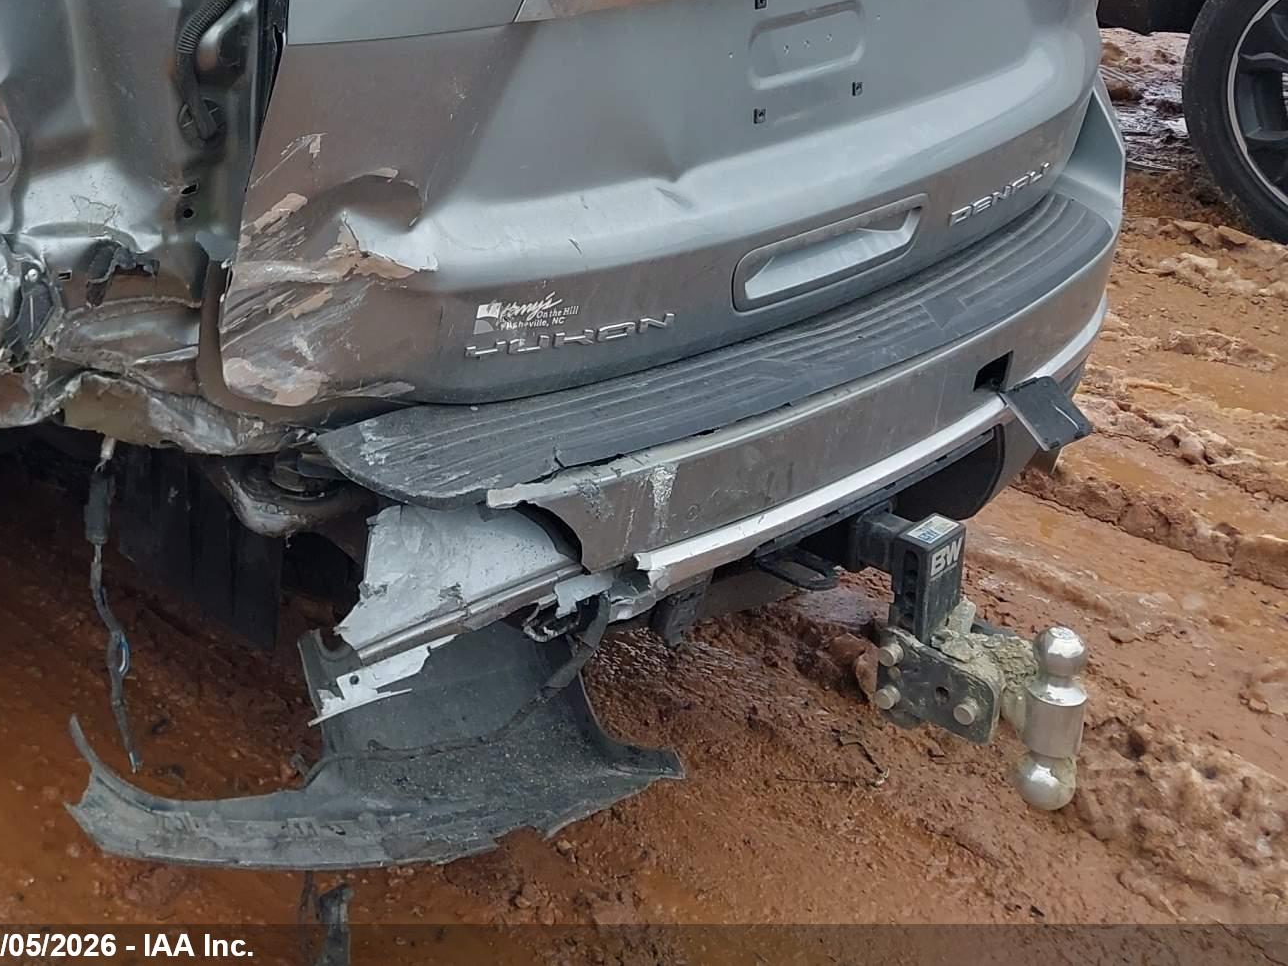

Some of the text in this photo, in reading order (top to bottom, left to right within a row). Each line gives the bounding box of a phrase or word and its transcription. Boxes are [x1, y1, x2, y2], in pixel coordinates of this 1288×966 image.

[947, 161, 1051, 228] DENALI
[552, 316, 566, 326] NC
[563, 305, 579, 316] Hill
[464, 312, 676, 358] YUKON
